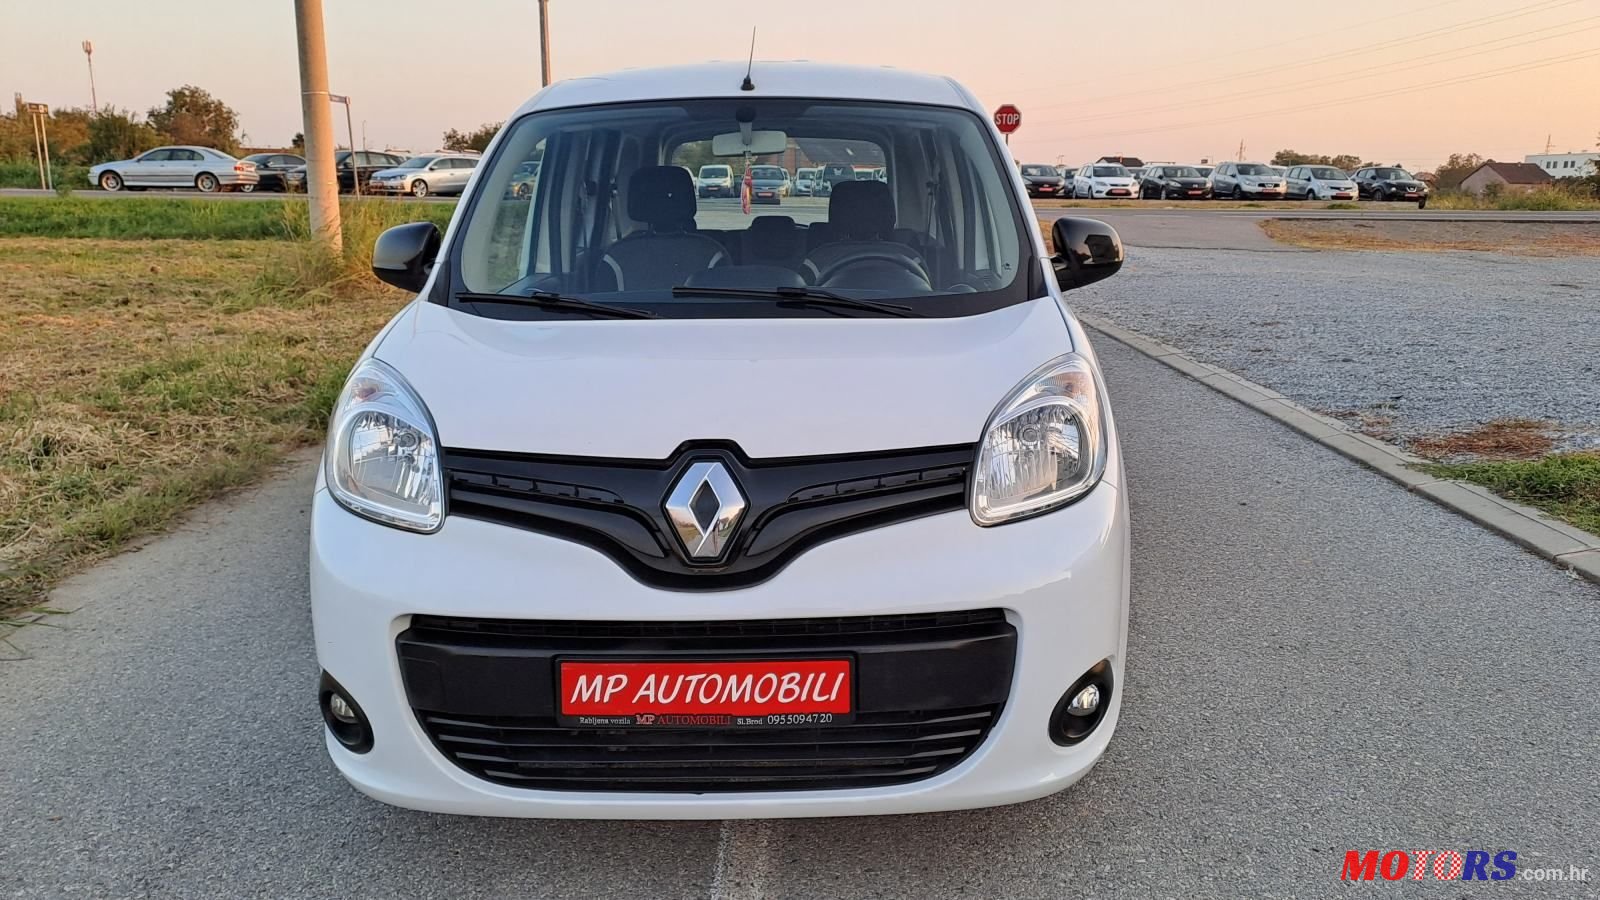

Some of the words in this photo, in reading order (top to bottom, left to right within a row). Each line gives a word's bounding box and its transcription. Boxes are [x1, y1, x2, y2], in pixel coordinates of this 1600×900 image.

[995, 113, 1020, 125] STOP
[570, 674, 628, 703] MP
[632, 672, 845, 704] AUTOMOBILI
[579, 717, 609, 725] Rabljena
[635, 714, 655, 725] MP
[657, 715, 731, 725] AUTOMOBILI
